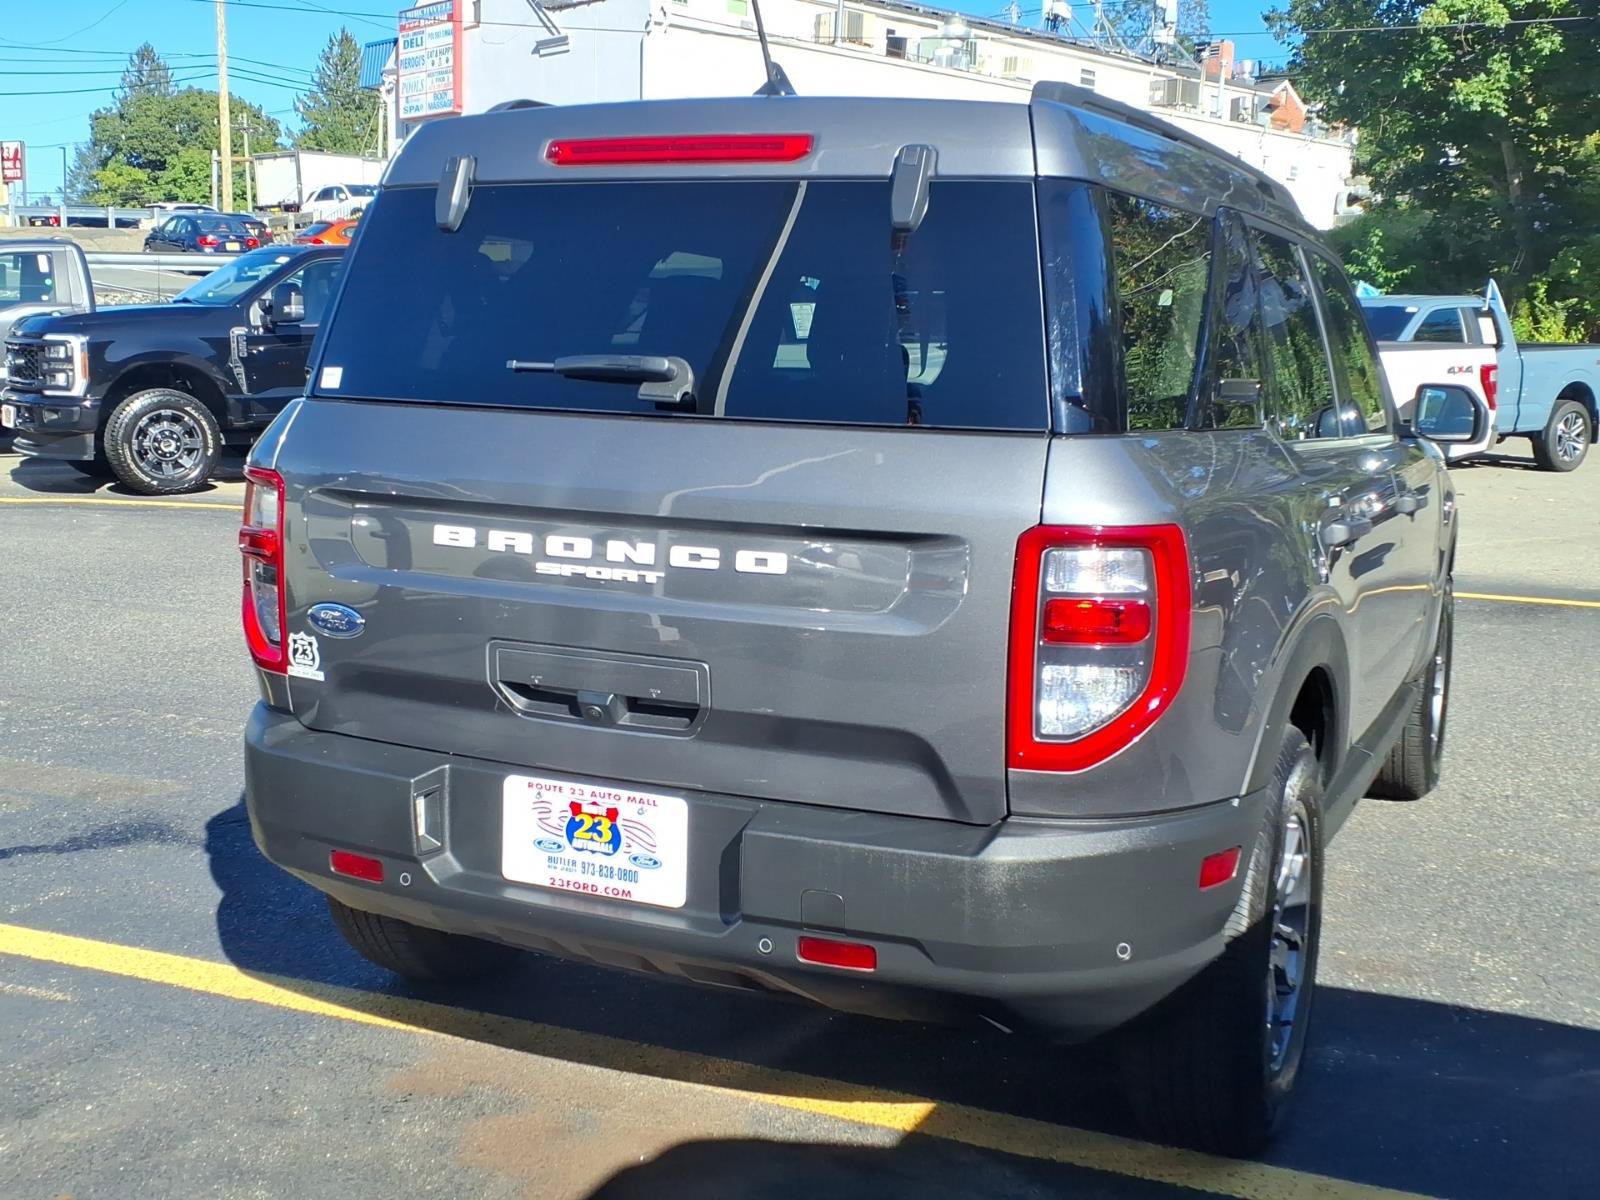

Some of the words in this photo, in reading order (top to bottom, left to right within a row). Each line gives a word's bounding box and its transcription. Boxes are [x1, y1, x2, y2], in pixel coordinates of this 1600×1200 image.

[403, 36, 423, 50] DELI
[401, 79, 424, 95] POOLS
[403, 104, 420, 114] SPA
[433, 524, 788, 575] BRONCO
[535, 562, 665, 584] SPORT
[294, 643, 314, 661] 23
[527, 781, 564, 793] ROUTE
[570, 787, 585, 797] 23
[590, 790, 622, 802] AUTO
[627, 795, 659, 808] MALL
[573, 813, 613, 843] 23
[547, 856, 577, 868] BUTLER
[581, 861, 639, 884] 973-838-0800
[549, 877, 633, 898] 23FORD.COM
